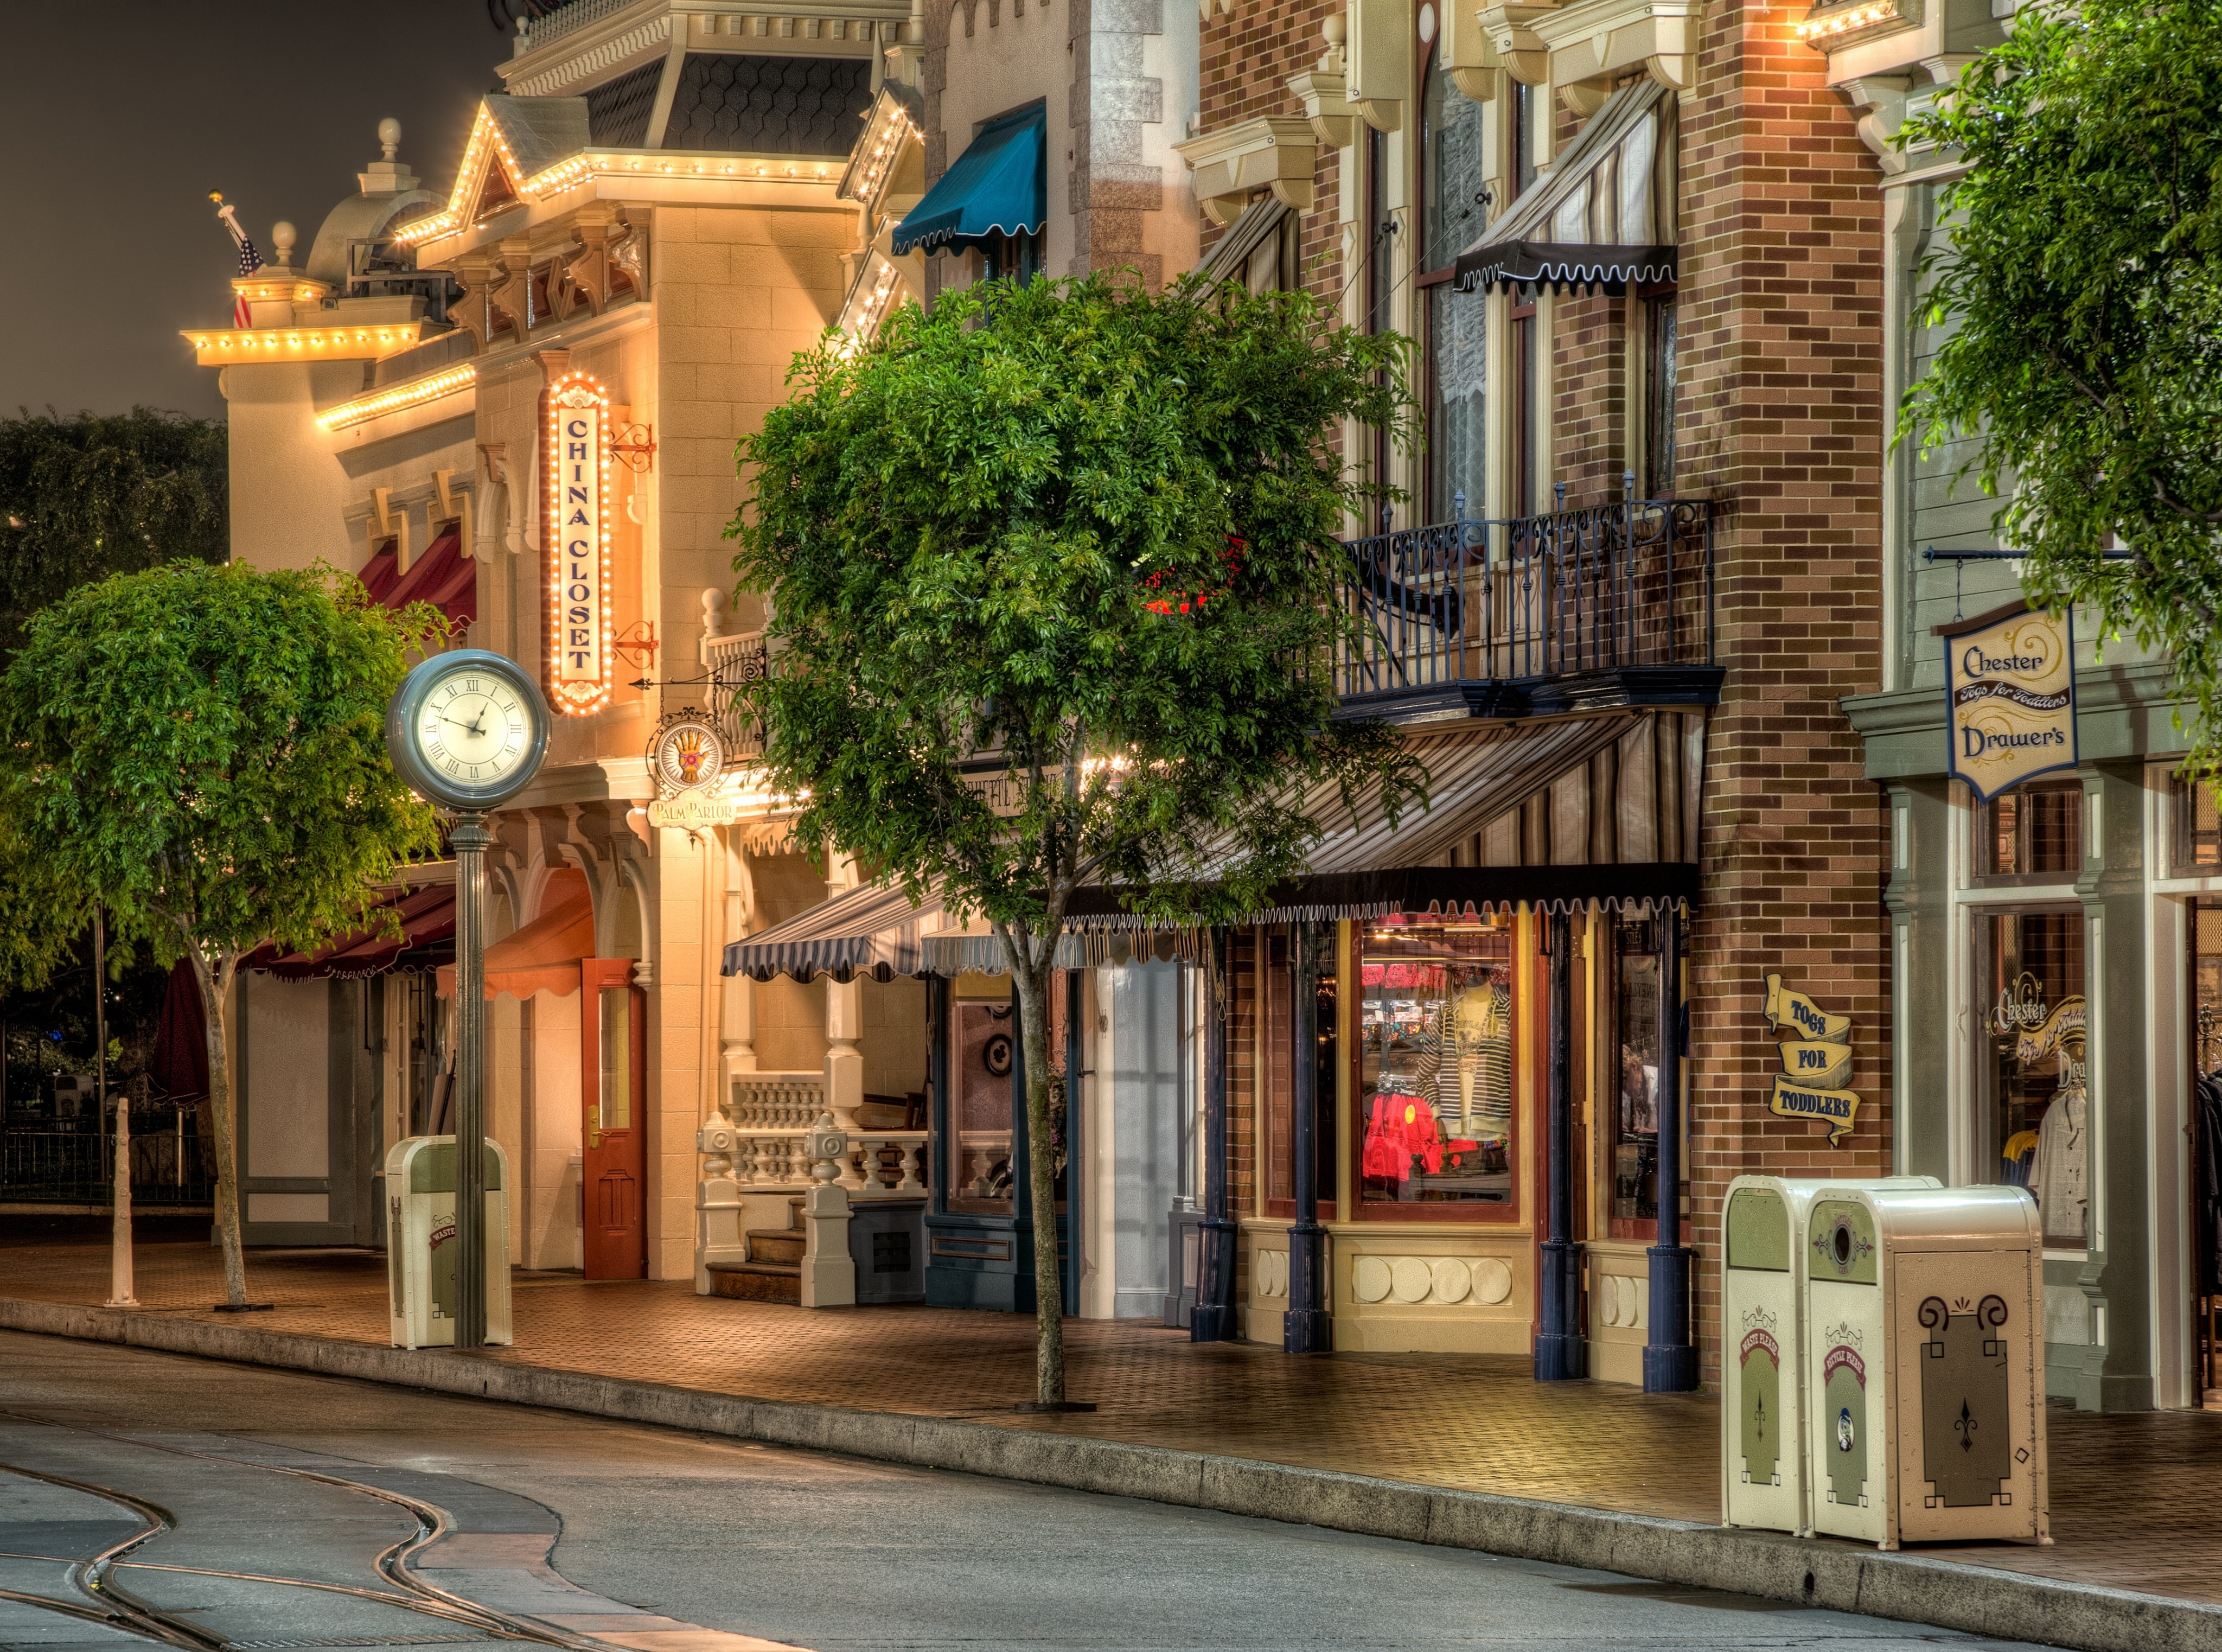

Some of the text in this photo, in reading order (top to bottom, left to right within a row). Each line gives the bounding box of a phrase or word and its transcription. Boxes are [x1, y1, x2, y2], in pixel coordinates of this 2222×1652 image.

[566, 419, 591, 669] CHINA CLOSET
[1963, 646, 2043, 678] Chester
[445, 684, 458, 698] XI
[466, 680, 479, 691] XII
[490, 686, 498, 697] I
[1960, 682, 2067, 709] Togs for Toddlers
[431, 702, 442, 712] X
[503, 701, 516, 712] II
[425, 724, 437, 733] IX
[510, 724, 522, 733] III
[429, 741, 445, 760] VIII
[505, 744, 518, 757] IV
[1961, 725, 2065, 757] Drawer's
[445, 759, 460, 774] VII
[469, 766, 480, 778] VI
[492, 761, 501, 773] V
[653, 802, 732, 827] PALM PARLOR
[1791, 999, 1827, 1035] TOGS
[1997, 987, 2047, 1033] Chester
[1797, 1049, 1828, 1068] FOR
[2057, 1044, 2086, 1092] Dra
[1779, 1089, 1851, 1118] TODDLERS
[432, 1227, 456, 1241] WASTE
[1741, 1332, 1778, 1357] WASTE PLEASE
[1826, 1350, 1863, 1374] RECYCLE PLEASE
